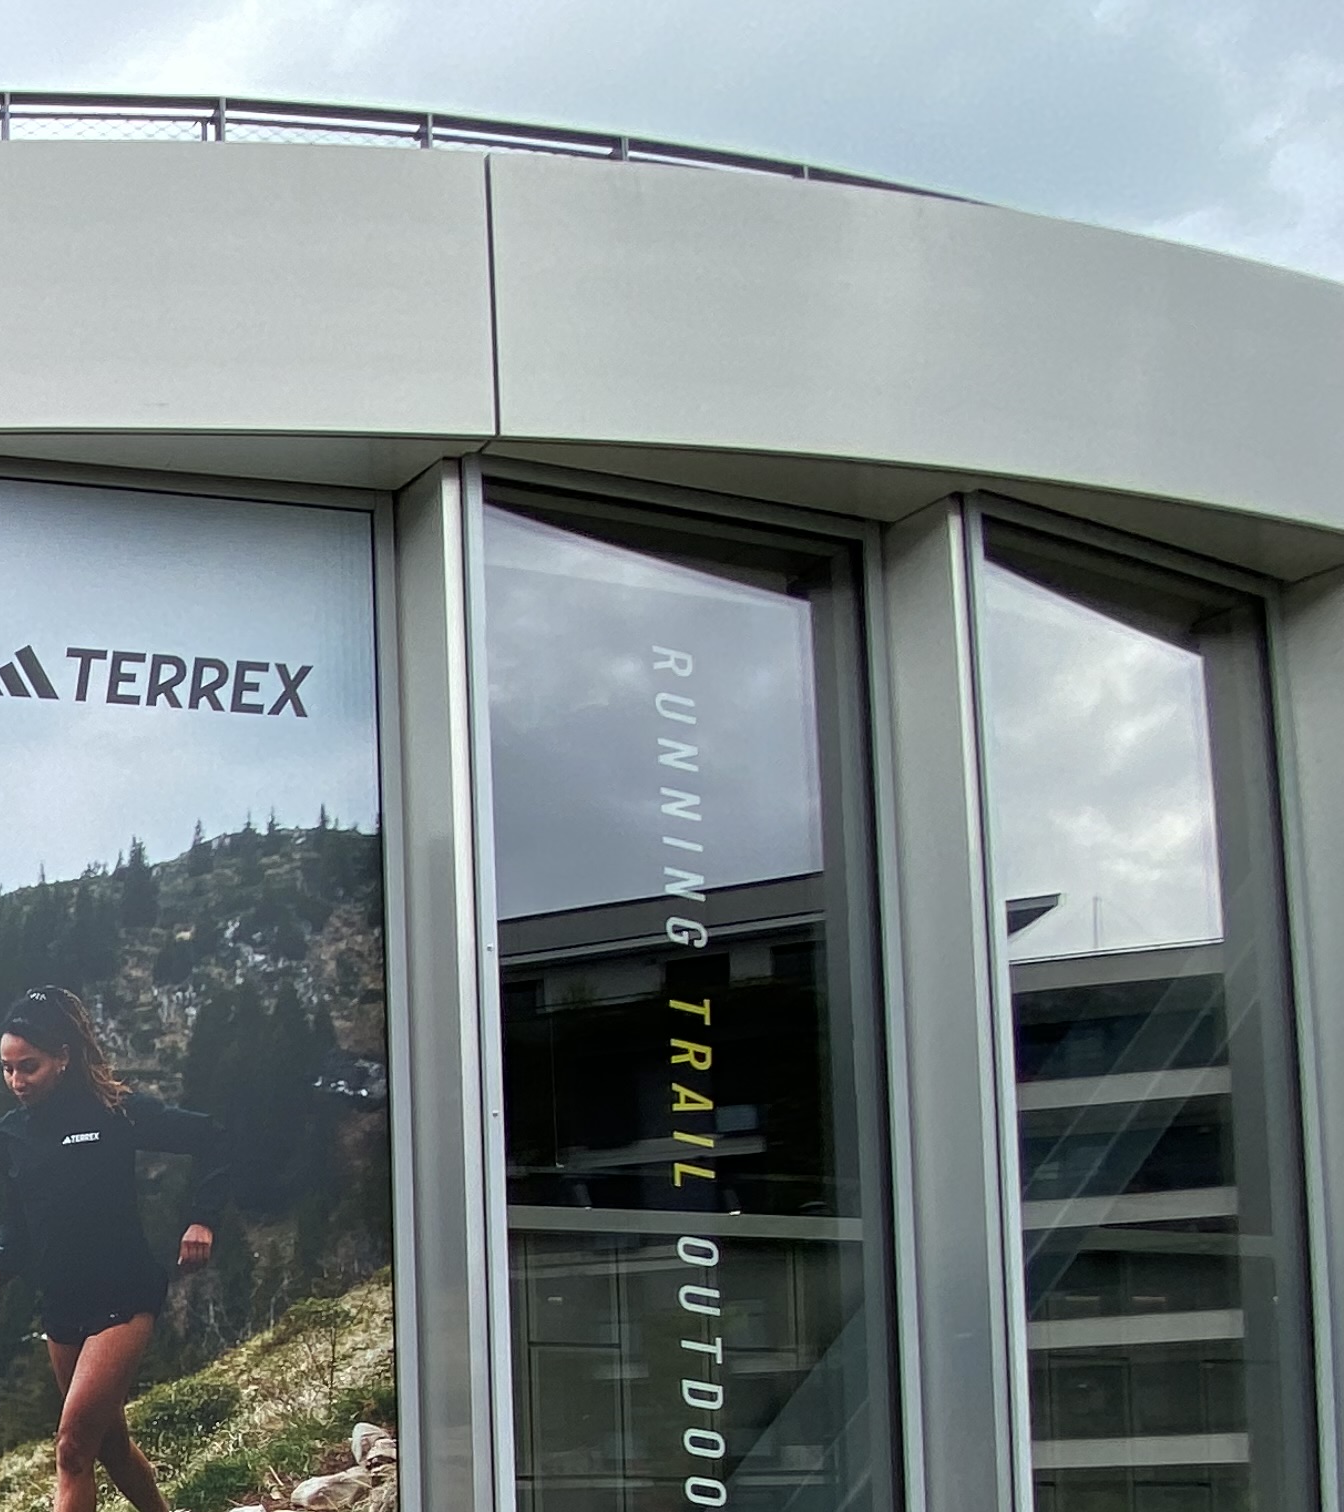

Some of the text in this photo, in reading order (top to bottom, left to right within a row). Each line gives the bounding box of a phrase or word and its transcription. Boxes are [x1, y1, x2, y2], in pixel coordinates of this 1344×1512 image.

[65, 646, 314, 718] TERREX
[651, 644, 709, 949] RUNNING
[70, 1132, 100, 1143] TERREX
[669, 998, 716, 1188] TRAIL
